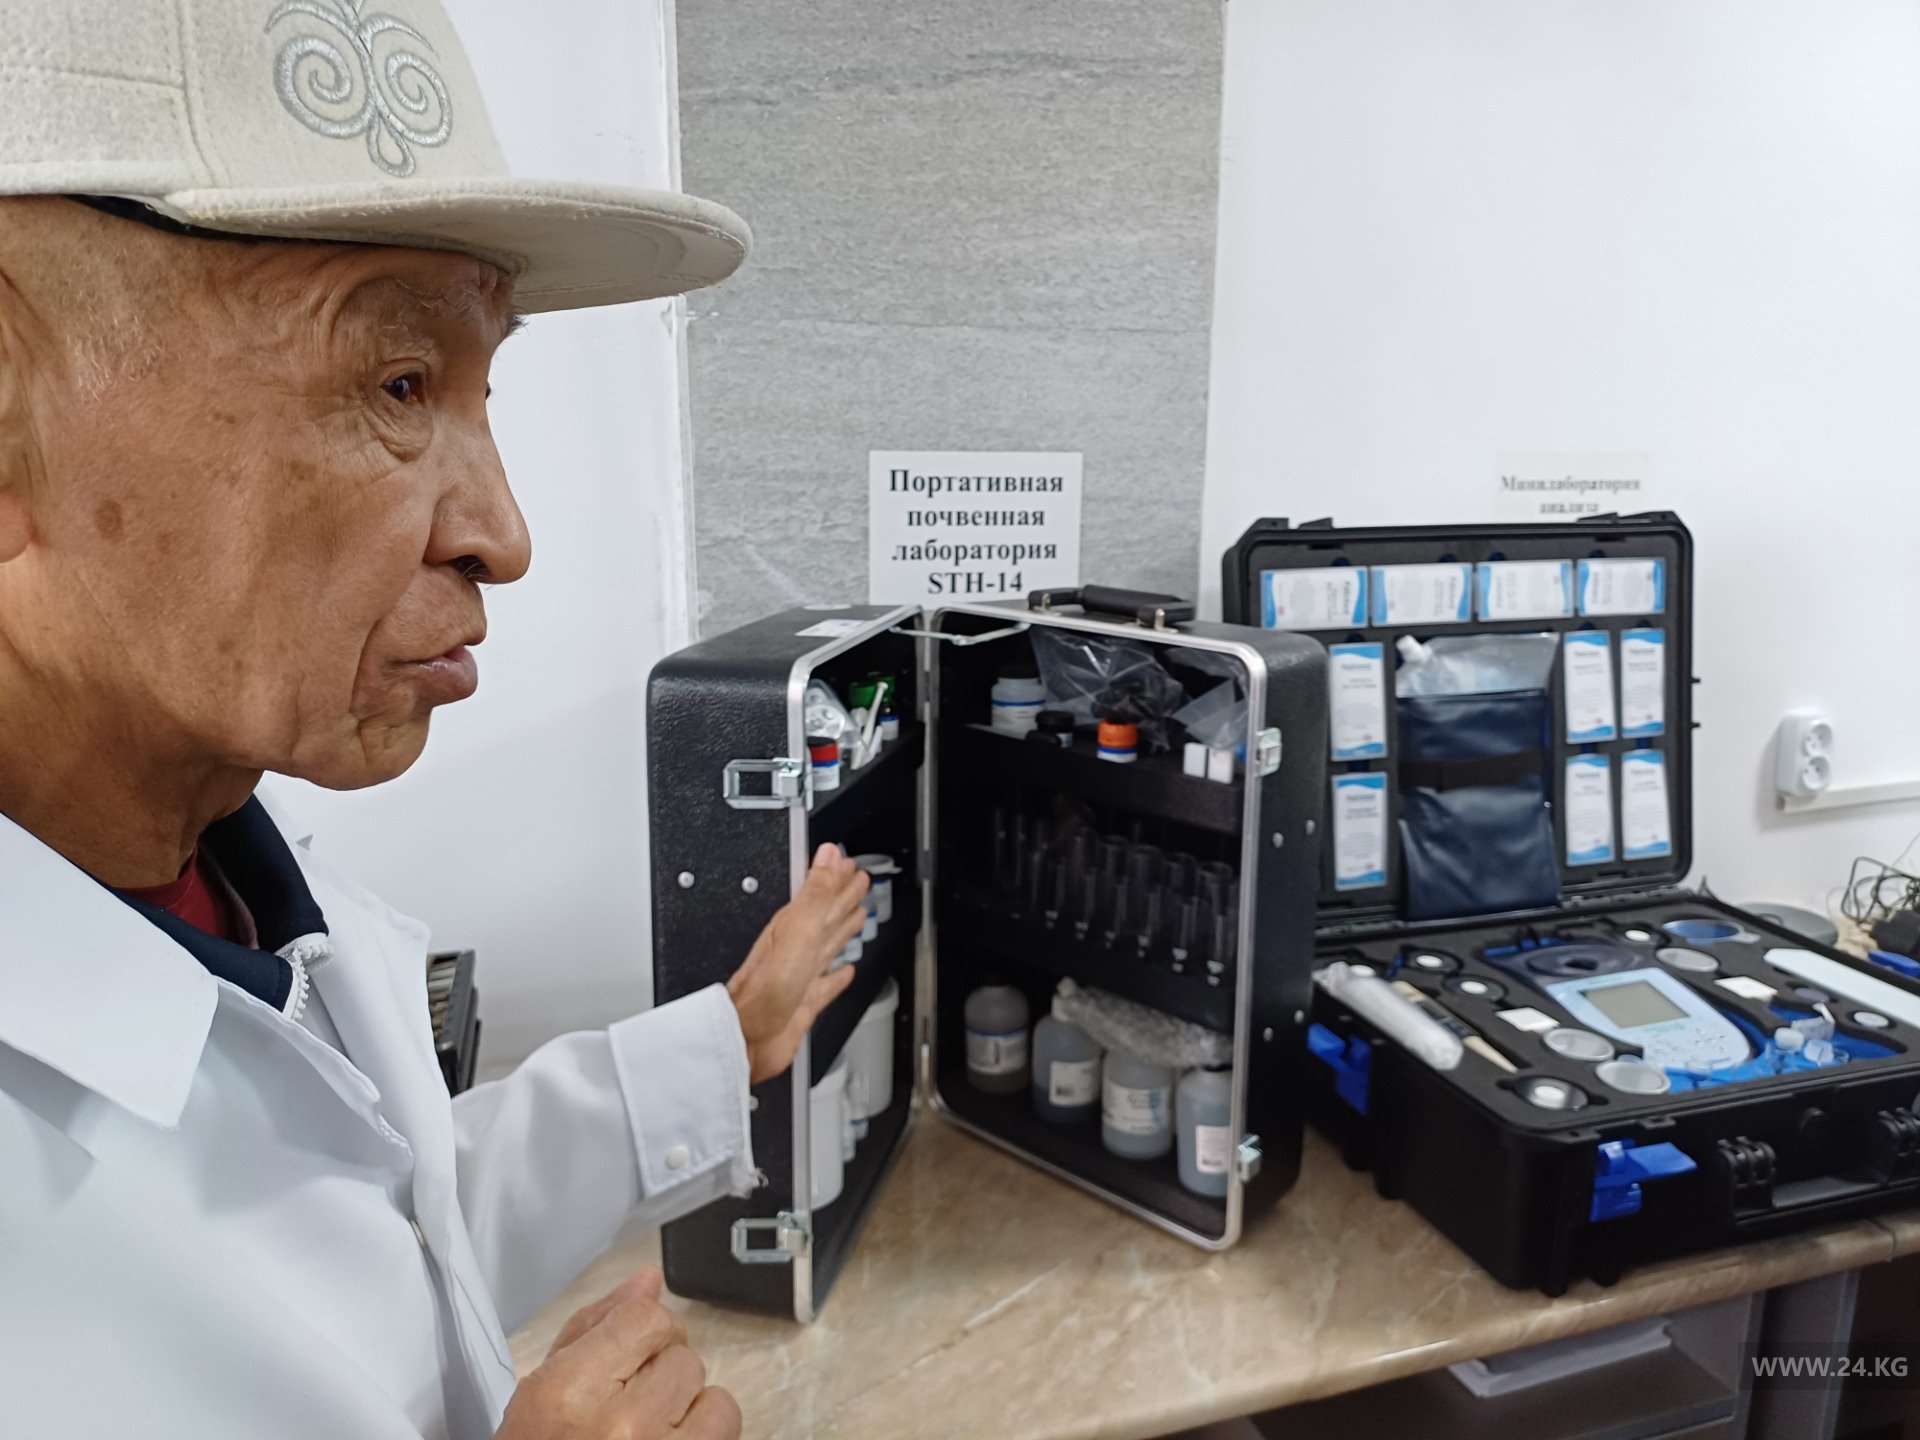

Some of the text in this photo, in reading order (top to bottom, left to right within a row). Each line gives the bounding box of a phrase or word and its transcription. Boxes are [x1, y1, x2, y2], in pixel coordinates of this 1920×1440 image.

[889, 469, 1064, 498] Портативная
[907, 509, 1046, 526] почвенная
[891, 539, 1058, 566] лаборатория
[928, 571, 1023, 594] STH-14
